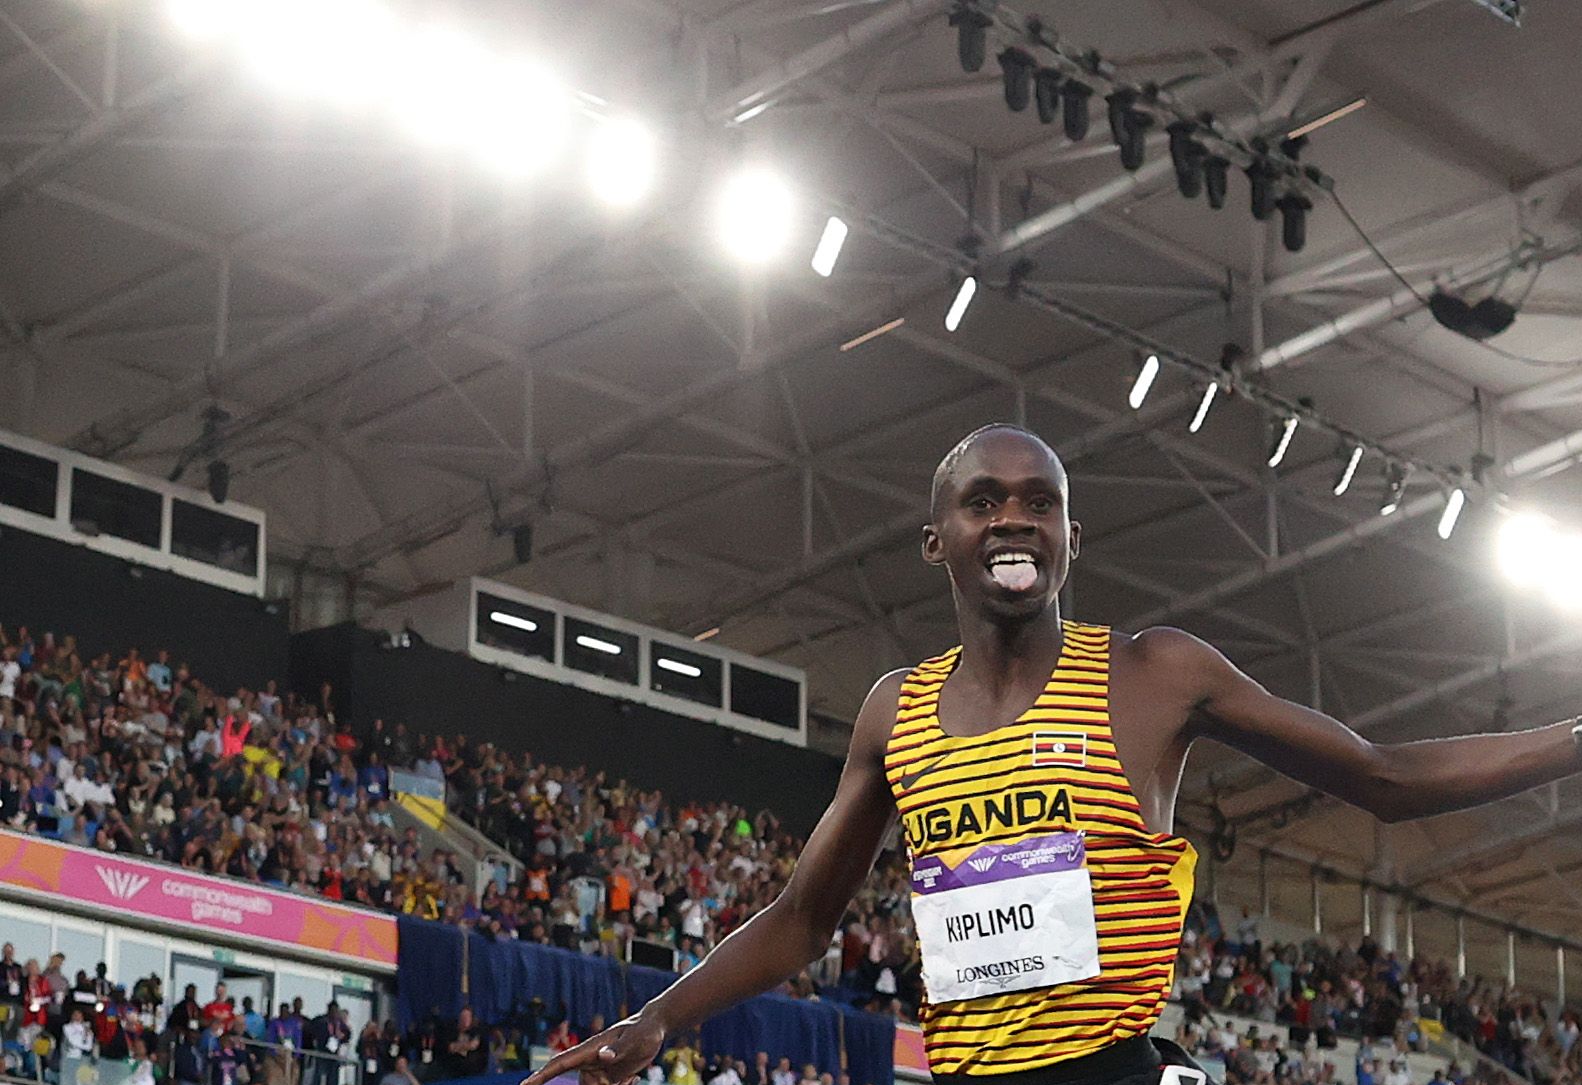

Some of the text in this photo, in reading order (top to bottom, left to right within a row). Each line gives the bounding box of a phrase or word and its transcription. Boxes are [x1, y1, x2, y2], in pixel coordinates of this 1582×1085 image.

[906, 788, 1072, 848] UGANDA
[1021, 854, 1056, 869] games
[945, 903, 1035, 943] KIPLIMO
[956, 956, 1045, 984] LONGINES
